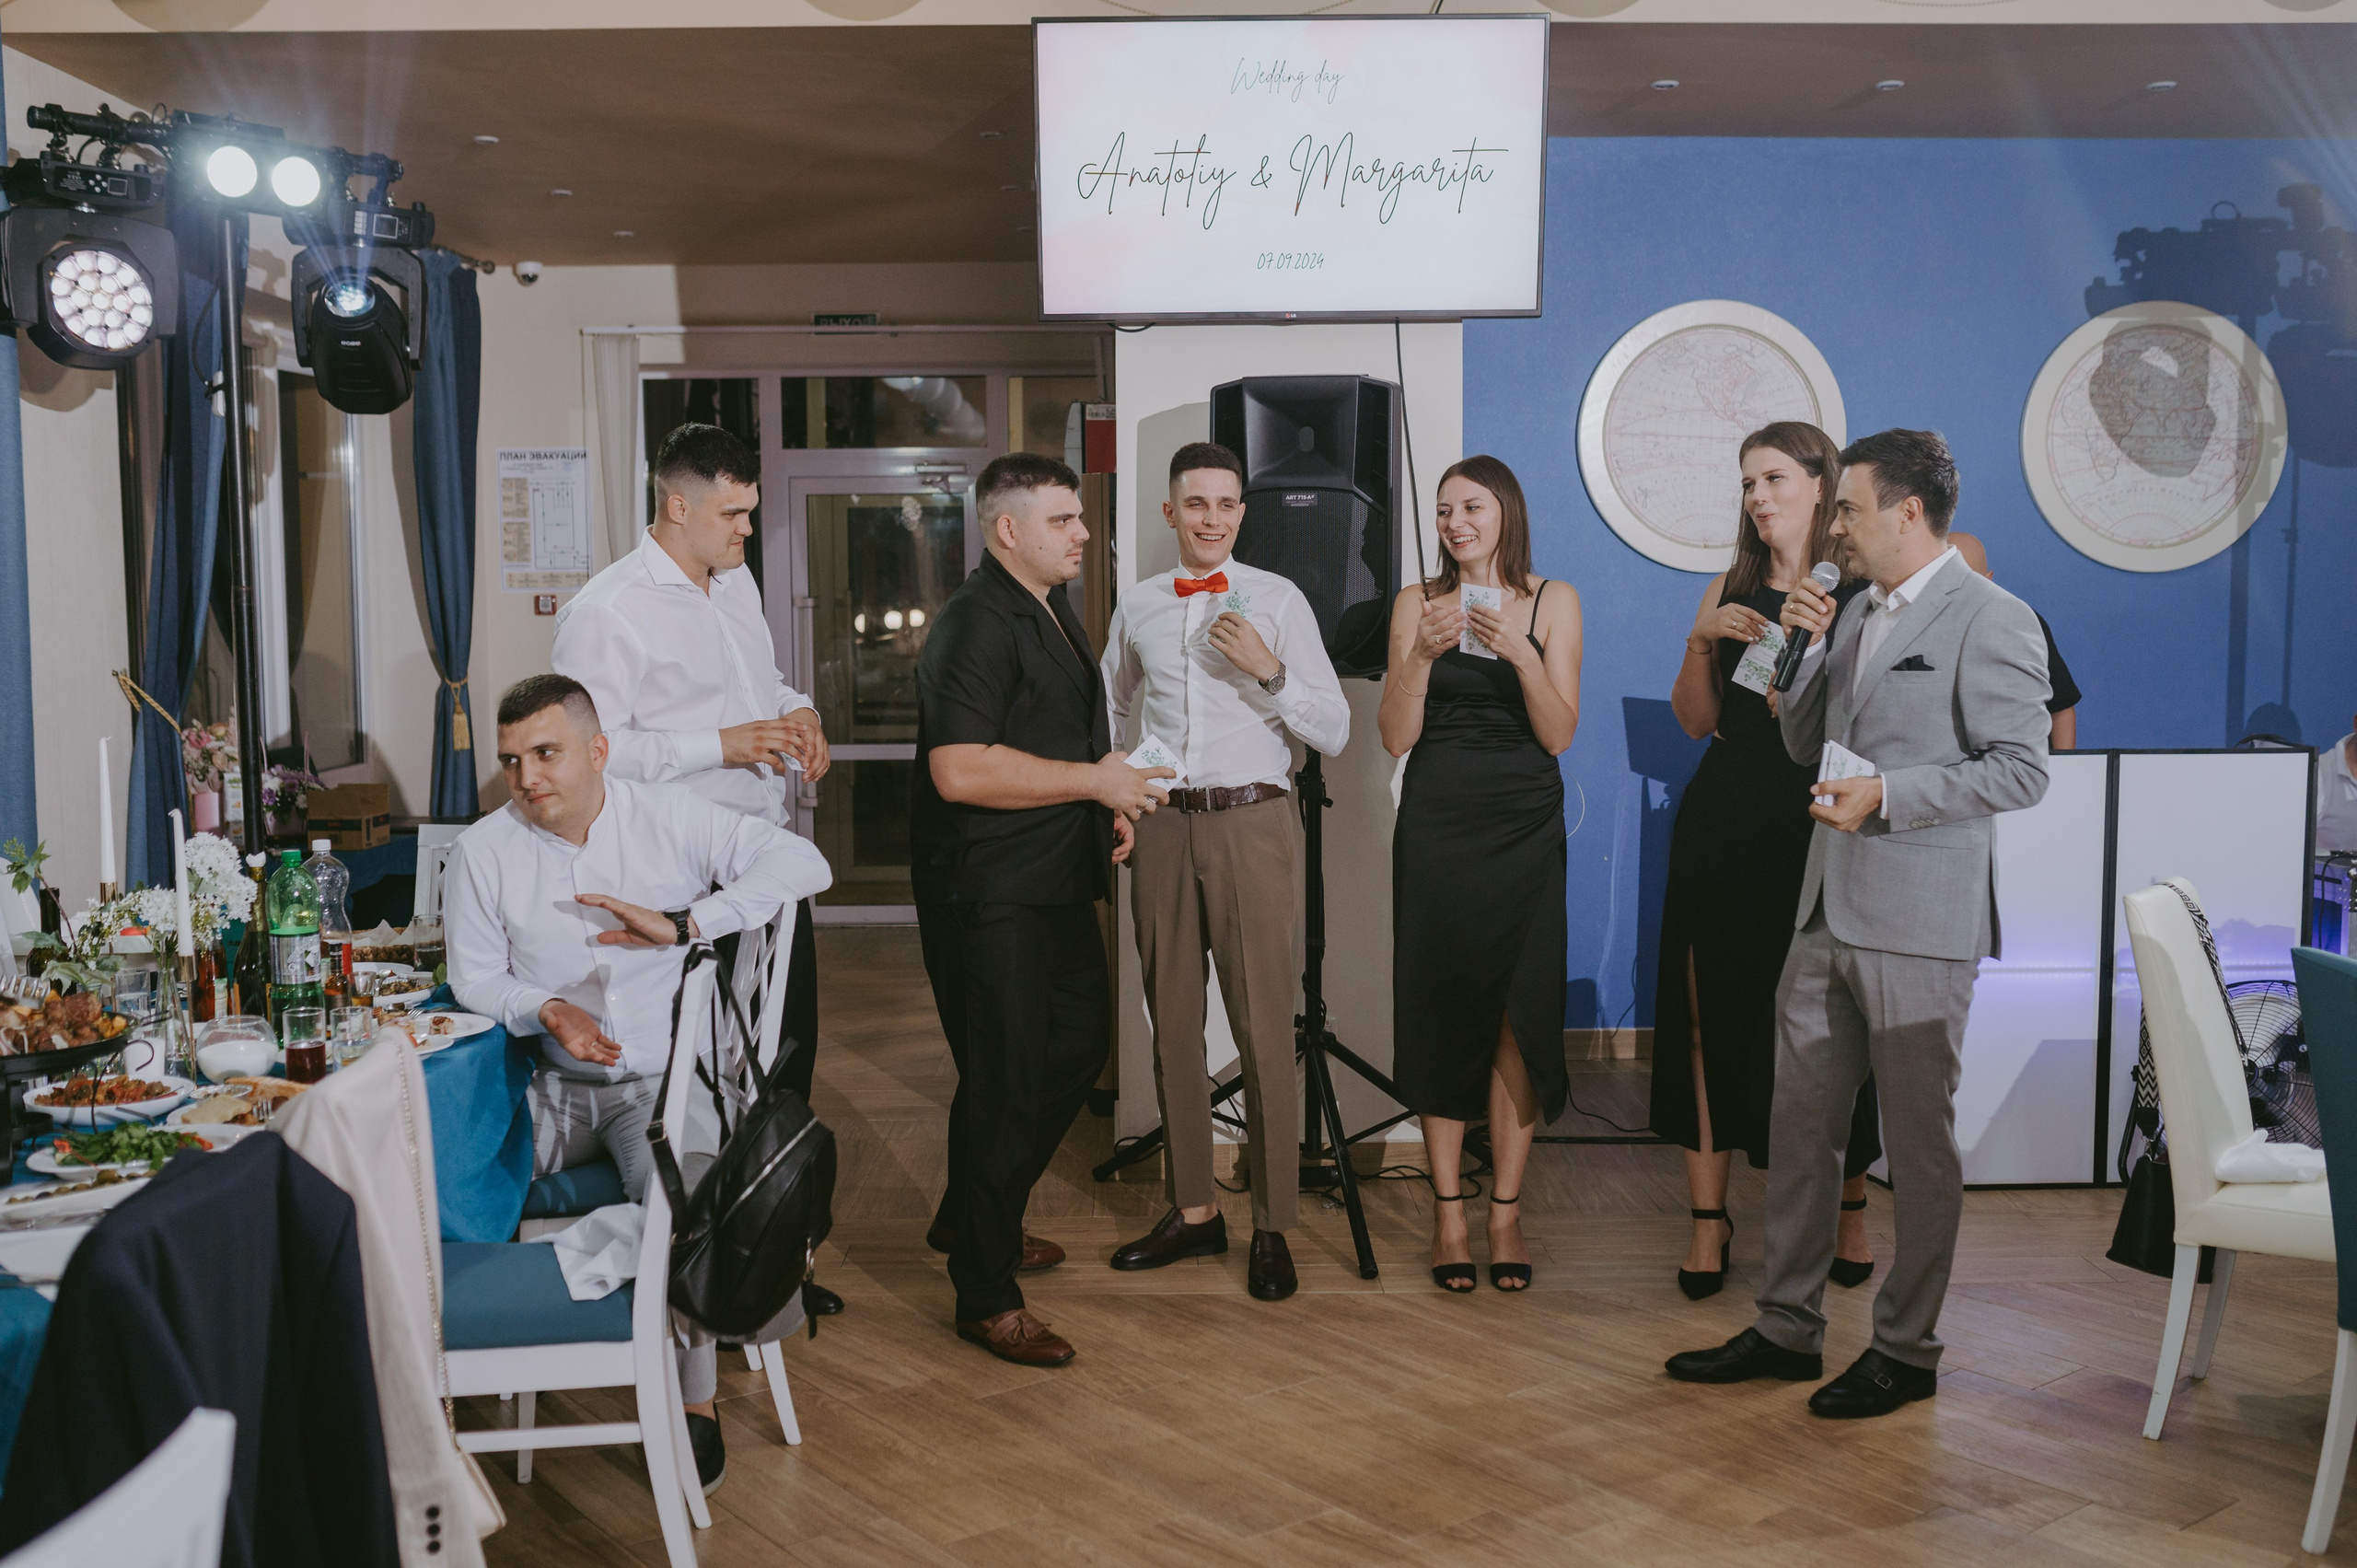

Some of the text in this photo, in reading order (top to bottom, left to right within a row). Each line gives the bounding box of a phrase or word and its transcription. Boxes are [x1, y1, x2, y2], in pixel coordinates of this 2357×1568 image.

[1230, 57, 1345, 105] Wedding day
[1250, 155, 1272, 189] &
[1289, 132, 1509, 225] Margarita
[1257, 252, 1324, 270] 07.09.2024
[500, 451, 586, 462] ПЛАН ЭВАКУАЦИИ
